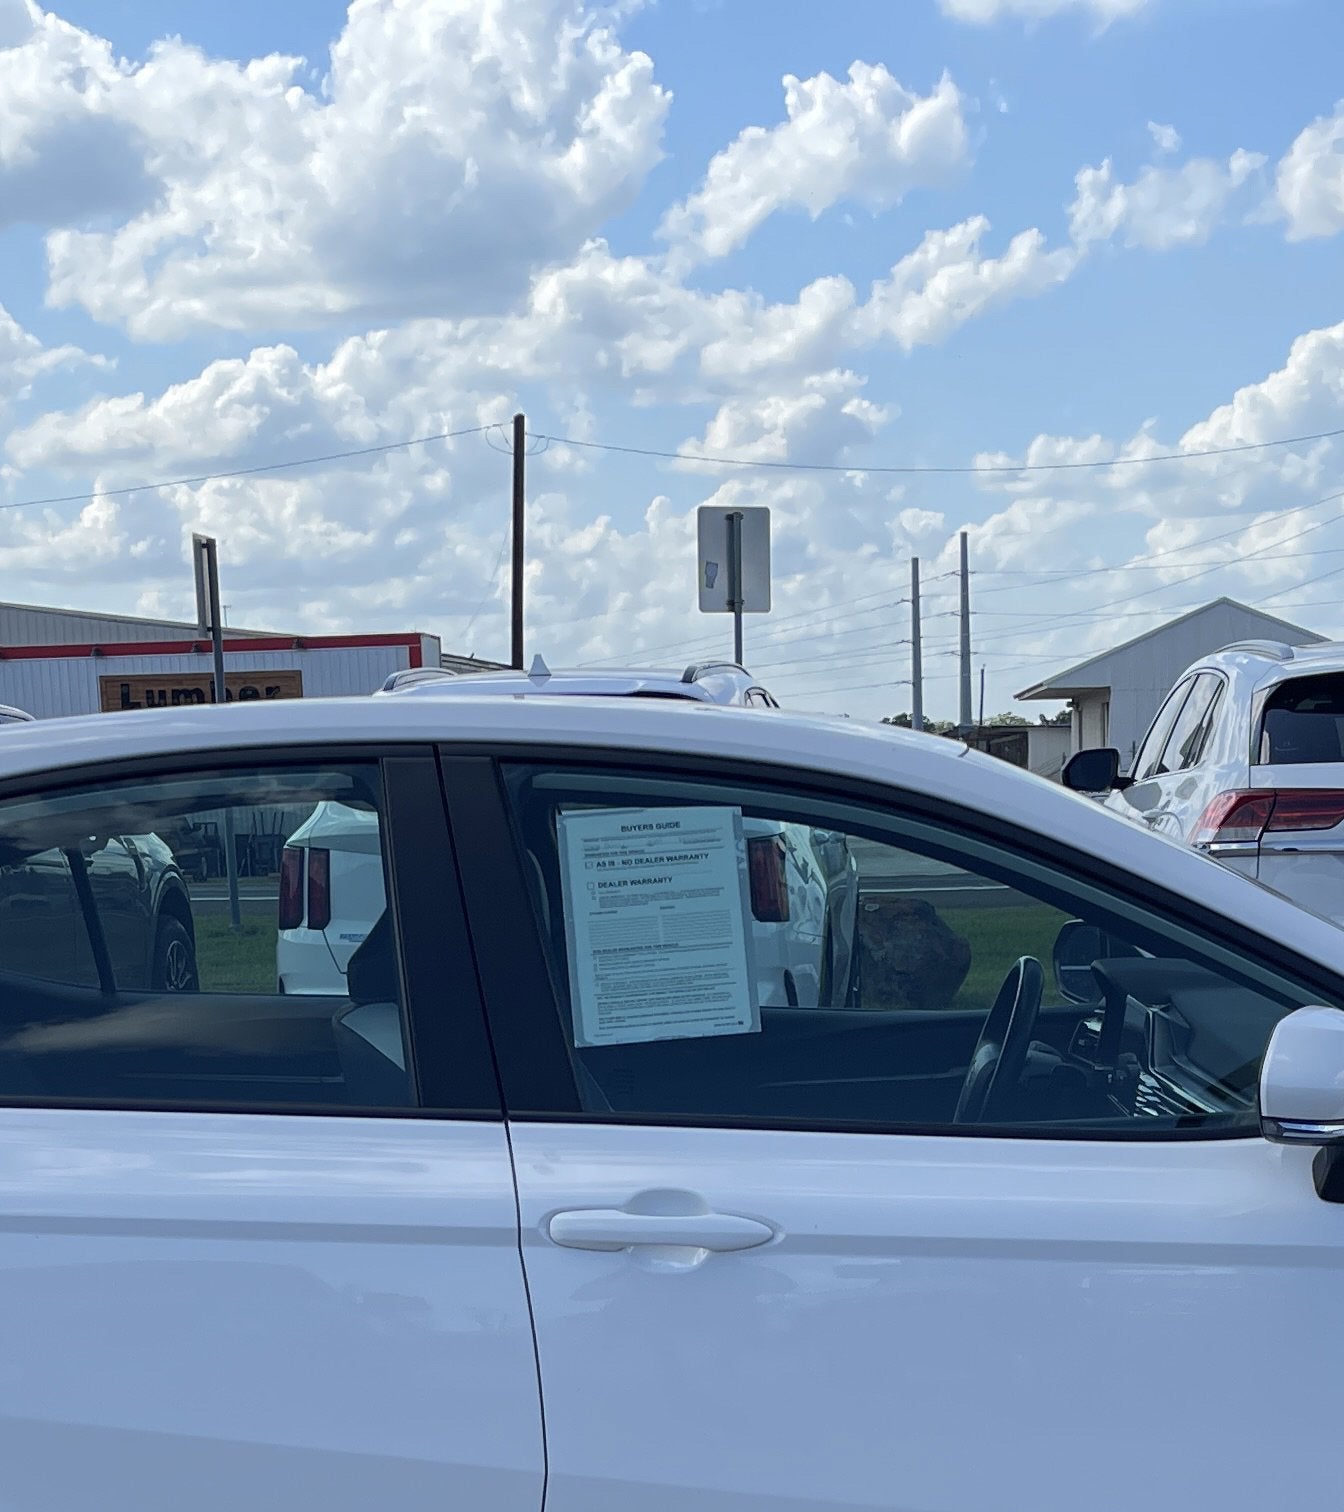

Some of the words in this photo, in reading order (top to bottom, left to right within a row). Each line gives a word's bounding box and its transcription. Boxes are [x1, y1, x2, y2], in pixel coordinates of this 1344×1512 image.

[621, 823, 653, 832] BUYERS
[656, 821, 680, 830] GUIDE
[634, 857, 665, 865] DEALER
[666, 853, 709, 862] WARRANTY
[598, 880, 628, 889] DEALER
[630, 876, 673, 886] WARRANTY
